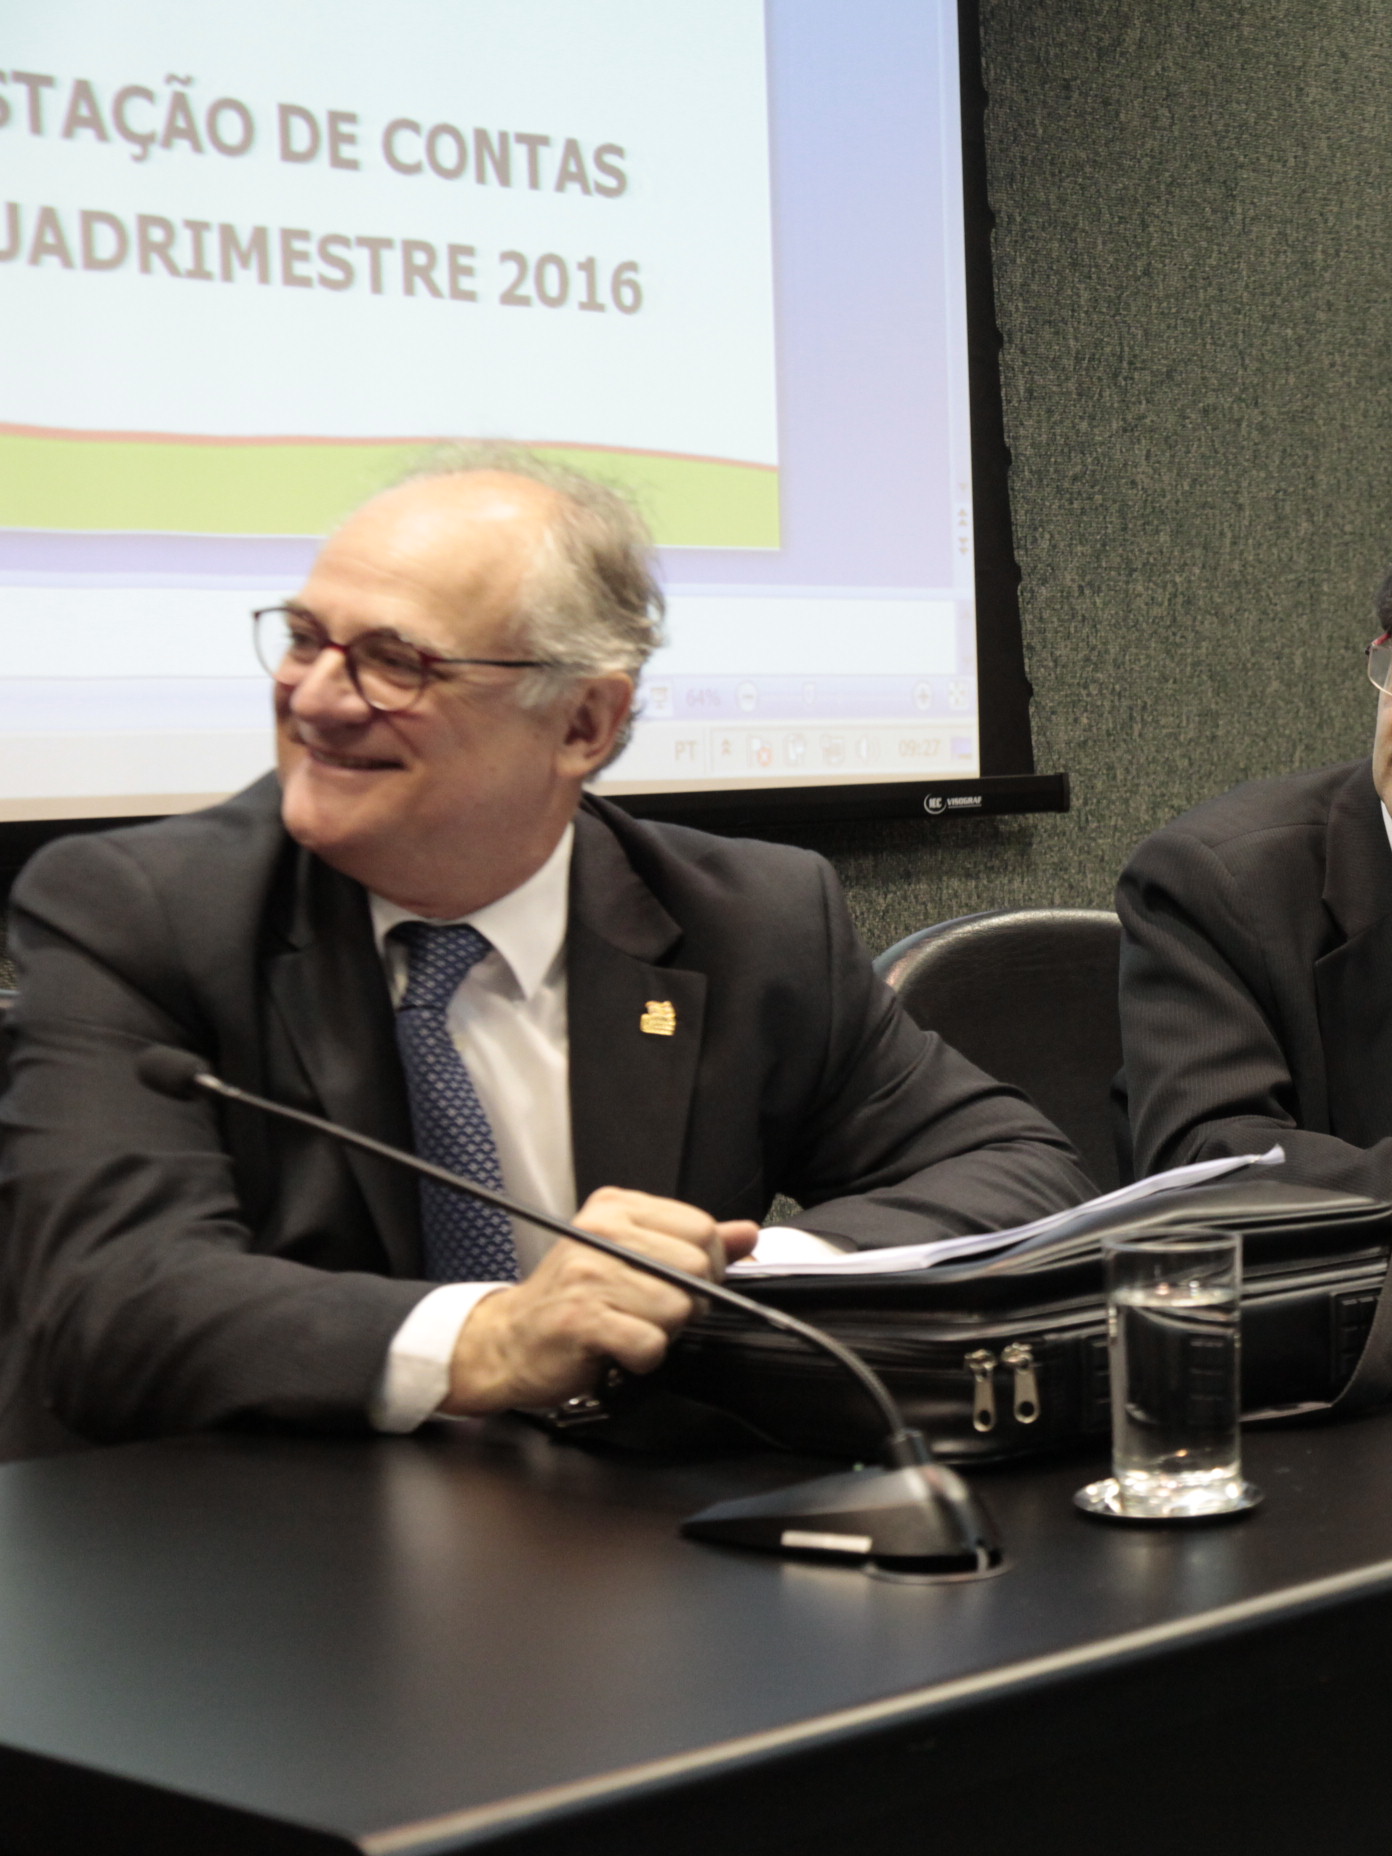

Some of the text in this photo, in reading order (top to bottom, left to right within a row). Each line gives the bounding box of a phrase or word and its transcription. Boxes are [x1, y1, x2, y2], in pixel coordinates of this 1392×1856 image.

[0, 69, 628, 199] TAÇÃO DE CONTAS
[498, 250, 644, 315] 2016
[674, 738, 942, 761] PT 09:27
